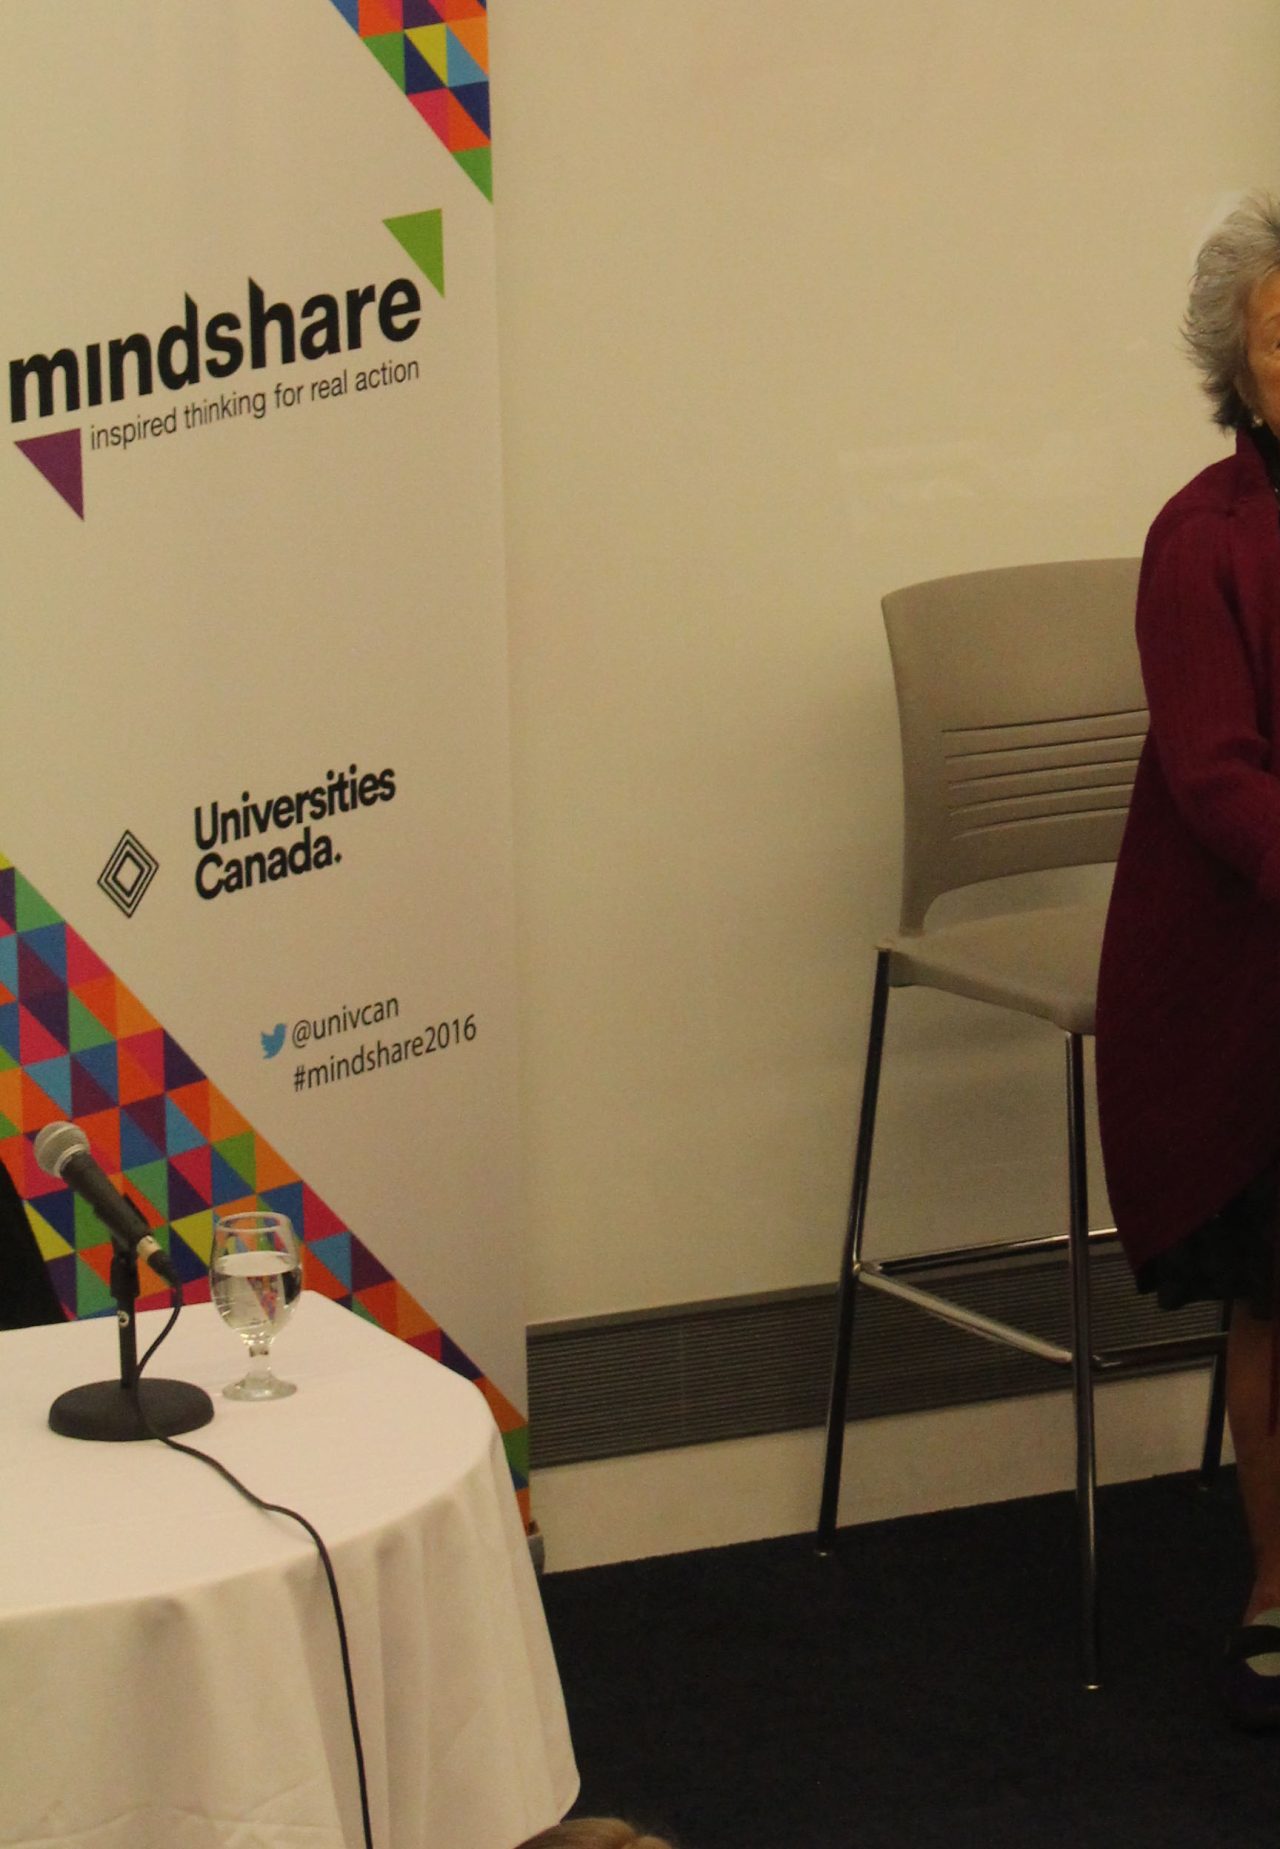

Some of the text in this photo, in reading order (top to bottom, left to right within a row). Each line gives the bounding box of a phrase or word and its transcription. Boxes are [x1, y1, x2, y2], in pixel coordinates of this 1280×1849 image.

[9, 277, 421, 424] mindshare
[91, 359, 419, 450] inspired thinking for real action
[194, 763, 396, 850] Universities
[194, 826, 342, 900] Canada.
[291, 997, 399, 1049] @univcan
[293, 1014, 477, 1092] #mindshare2016
